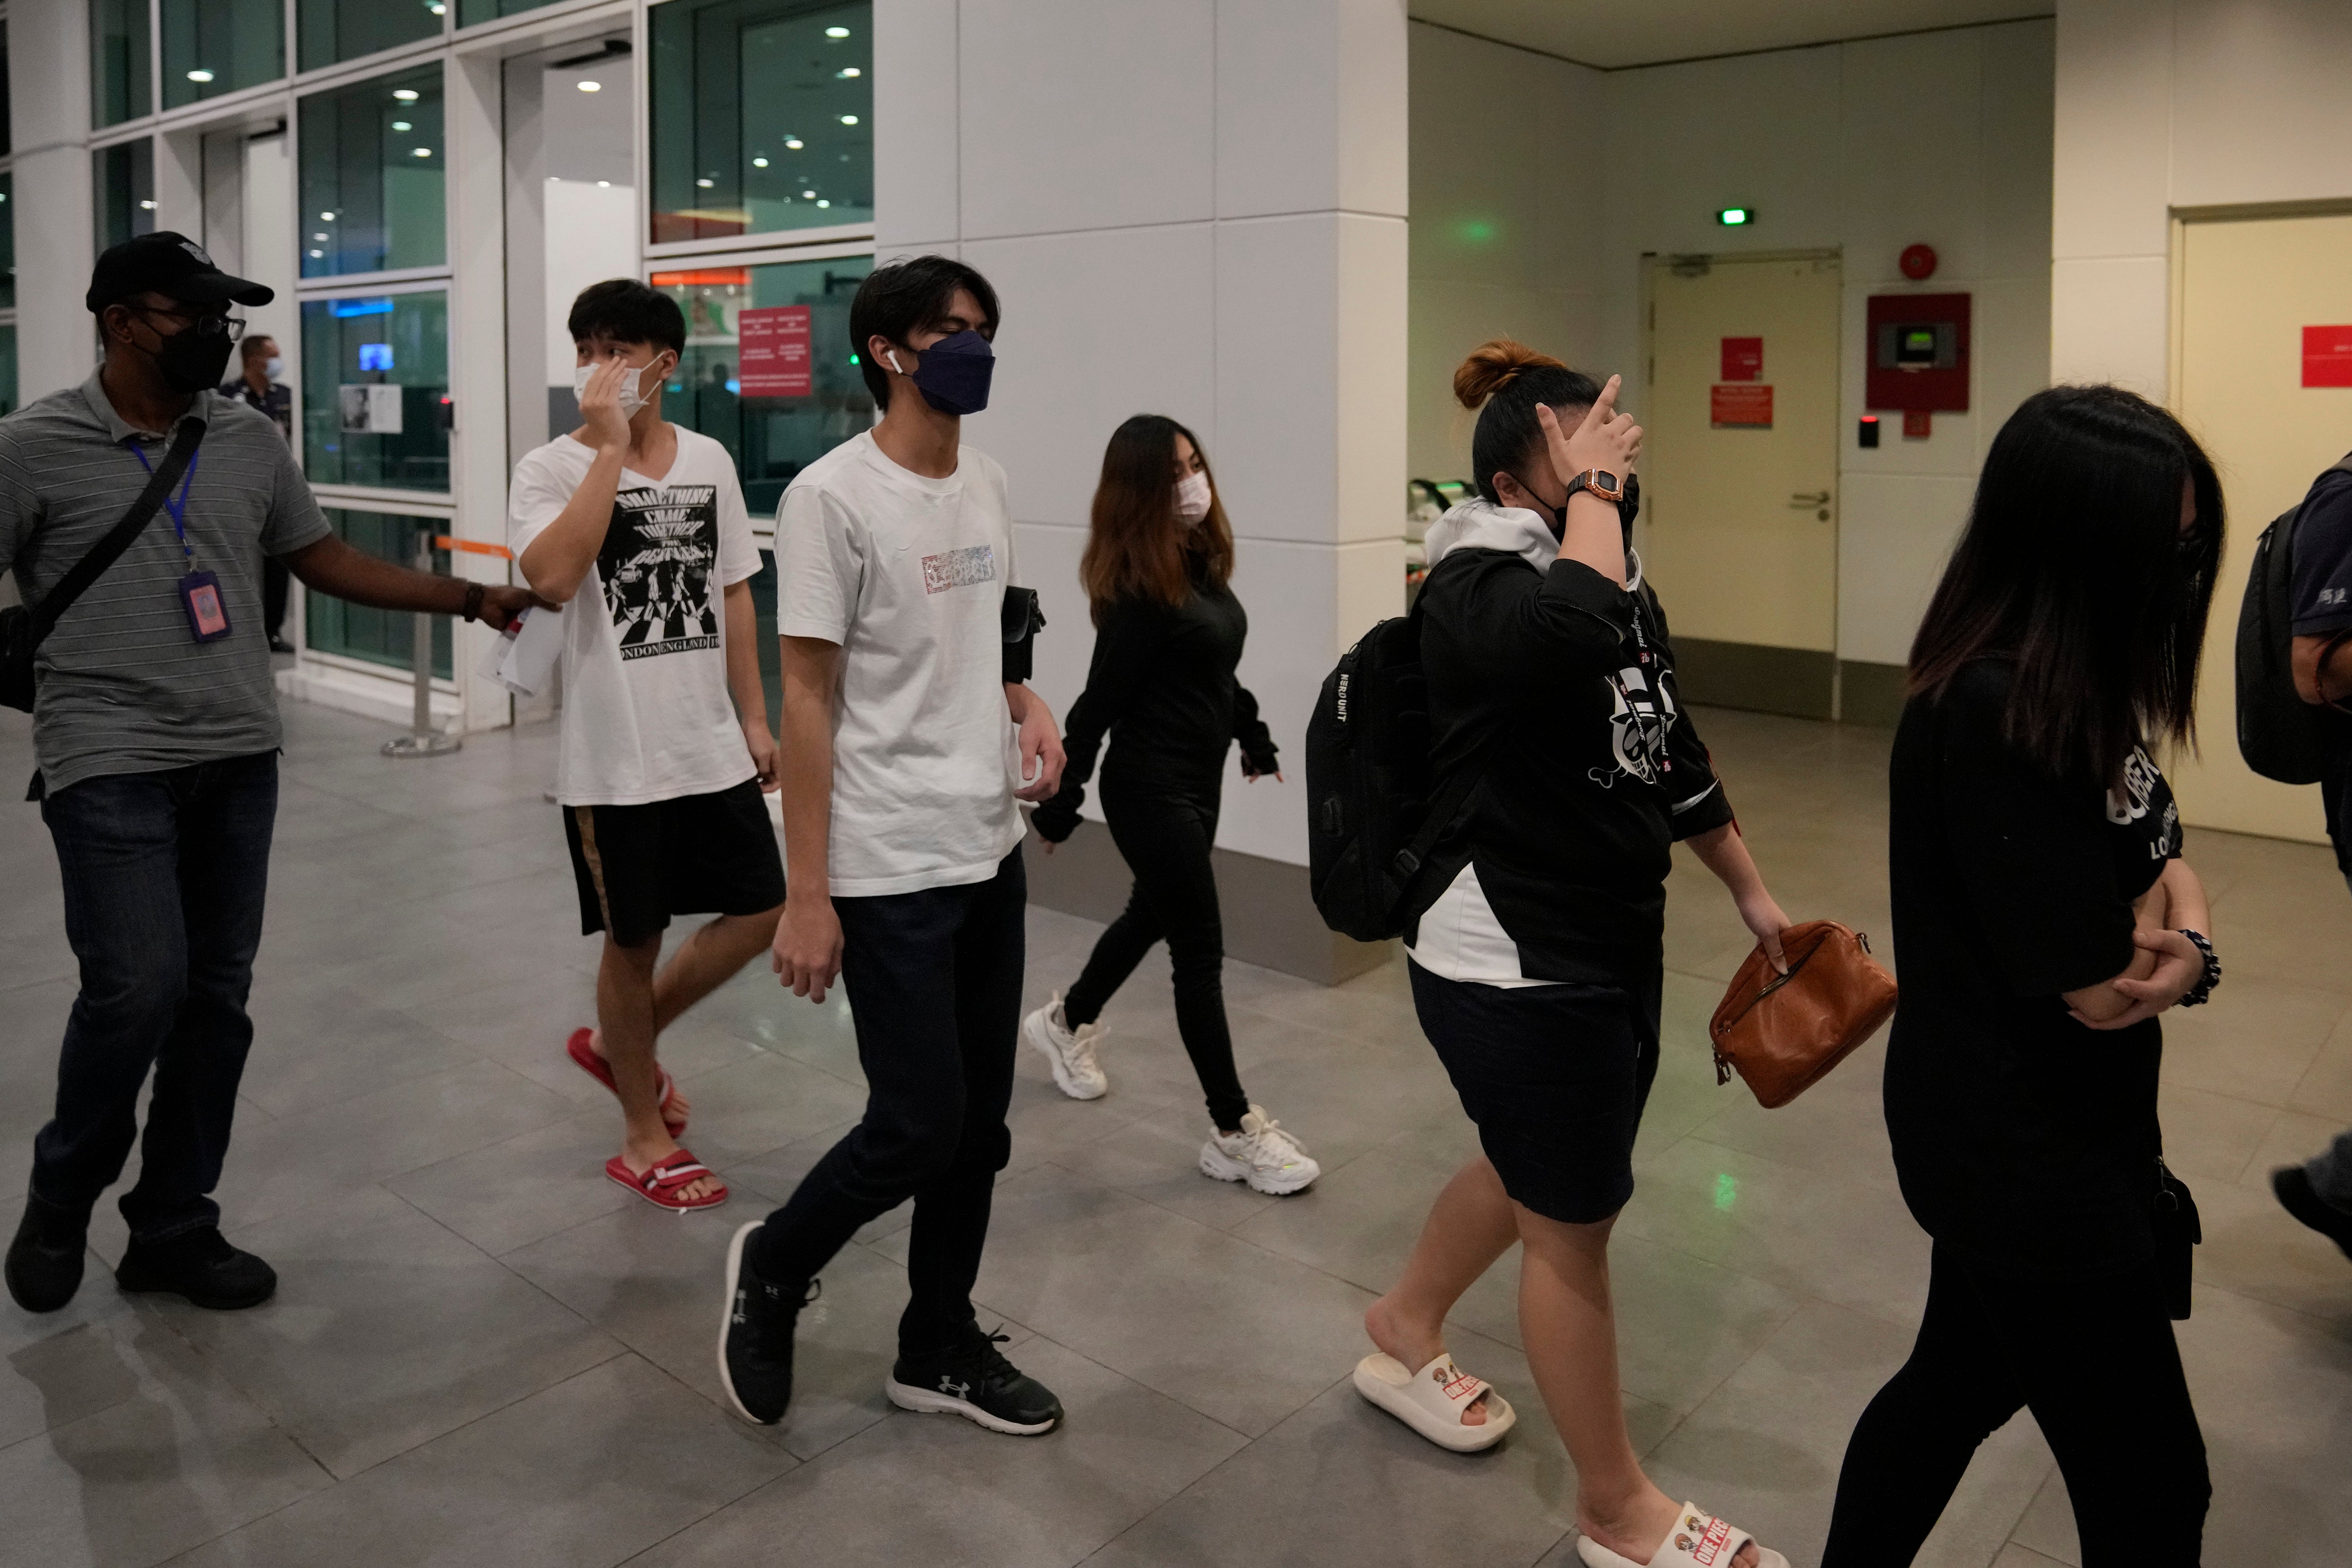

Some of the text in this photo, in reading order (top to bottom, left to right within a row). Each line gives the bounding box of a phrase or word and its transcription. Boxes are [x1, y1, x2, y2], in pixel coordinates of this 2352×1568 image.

[1337, 674, 1349, 722] NERD UNIT
[1706, 1519, 1730, 1544] PIEC
[1696, 1539, 1719, 1564] ONE
